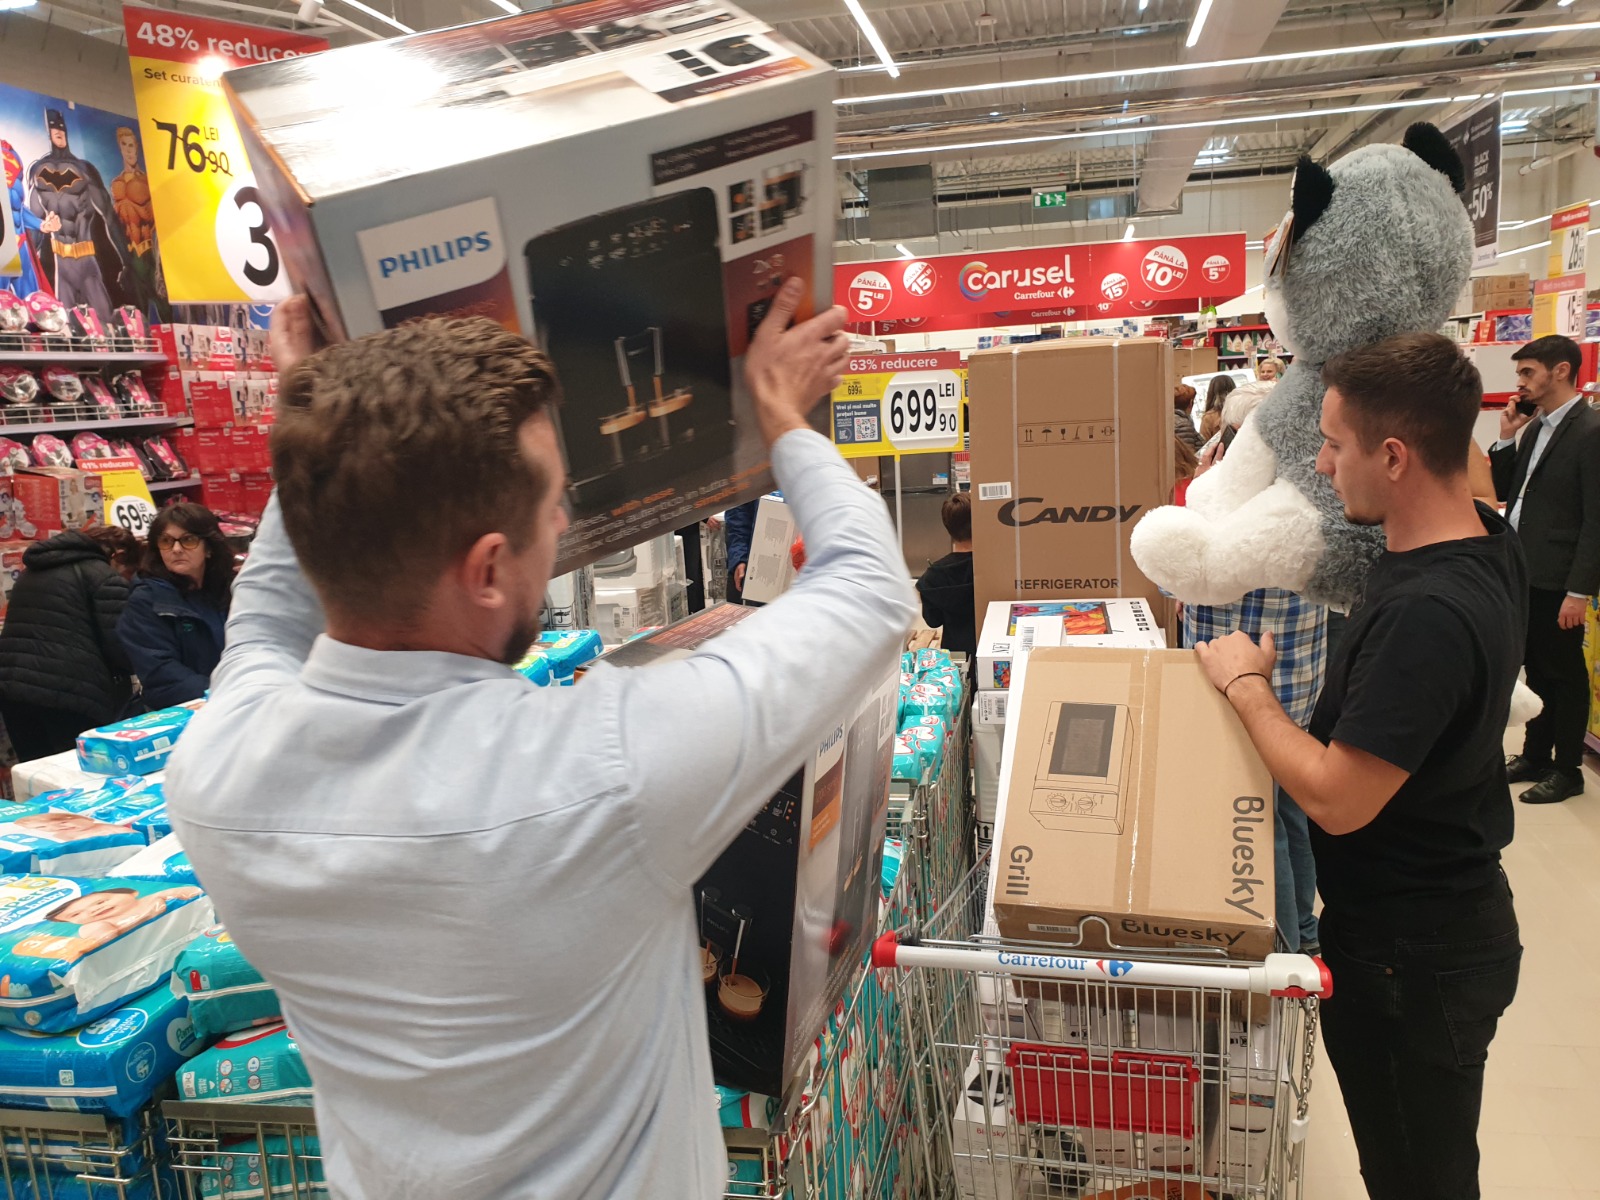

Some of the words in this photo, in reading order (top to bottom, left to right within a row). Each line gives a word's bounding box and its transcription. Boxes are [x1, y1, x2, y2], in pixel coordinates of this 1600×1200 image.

[137, 21, 199, 51] 48%
[207, 36, 309, 62] reduce
[144, 68, 167, 81] Set
[204, 127, 219, 141] LEI
[154, 120, 206, 173] 76
[1474, 150, 1490, 167] BLACK
[1473, 163, 1489, 178] FRIDAY
[234, 186, 279, 287] 3
[377, 231, 492, 279] PHILIPS
[1175, 259, 1185, 268] LA
[1146, 262, 1173, 287] 10
[1172, 270, 1184, 279] LEI
[1209, 268, 1219, 280] 5
[911, 275, 932, 294] 15
[1105, 286, 1123, 299] 15
[857, 290, 873, 310] 5
[873, 292, 884, 300] LEI
[1014, 291, 1055, 301] Carrefour
[1031, 310, 1061, 318] Carrefour
[882, 323, 889, 332] 5
[849, 359, 878, 371] 63%
[881, 357, 938, 370] reducere
[939, 383, 955, 397] LEI
[890, 388, 937, 434] 699
[939, 413, 957, 432] 90
[99, 460, 135, 469] reducere
[137, 503, 147, 512] LEI
[998, 497, 1142, 528] CANDY
[116, 504, 143, 530] 69
[1014, 578, 1119, 591] REFRIGERATOR
[819, 724, 844, 758] PHILIPS
[1225, 795, 1265, 920] Bluesky
[1006, 845, 1033, 896] Grill
[1121, 919, 1246, 945] Bluesky
[997, 952, 1088, 970] Carrefour
[176, 1025, 194, 1043] Pam
[976, 1128, 1006, 1138] Blsky
